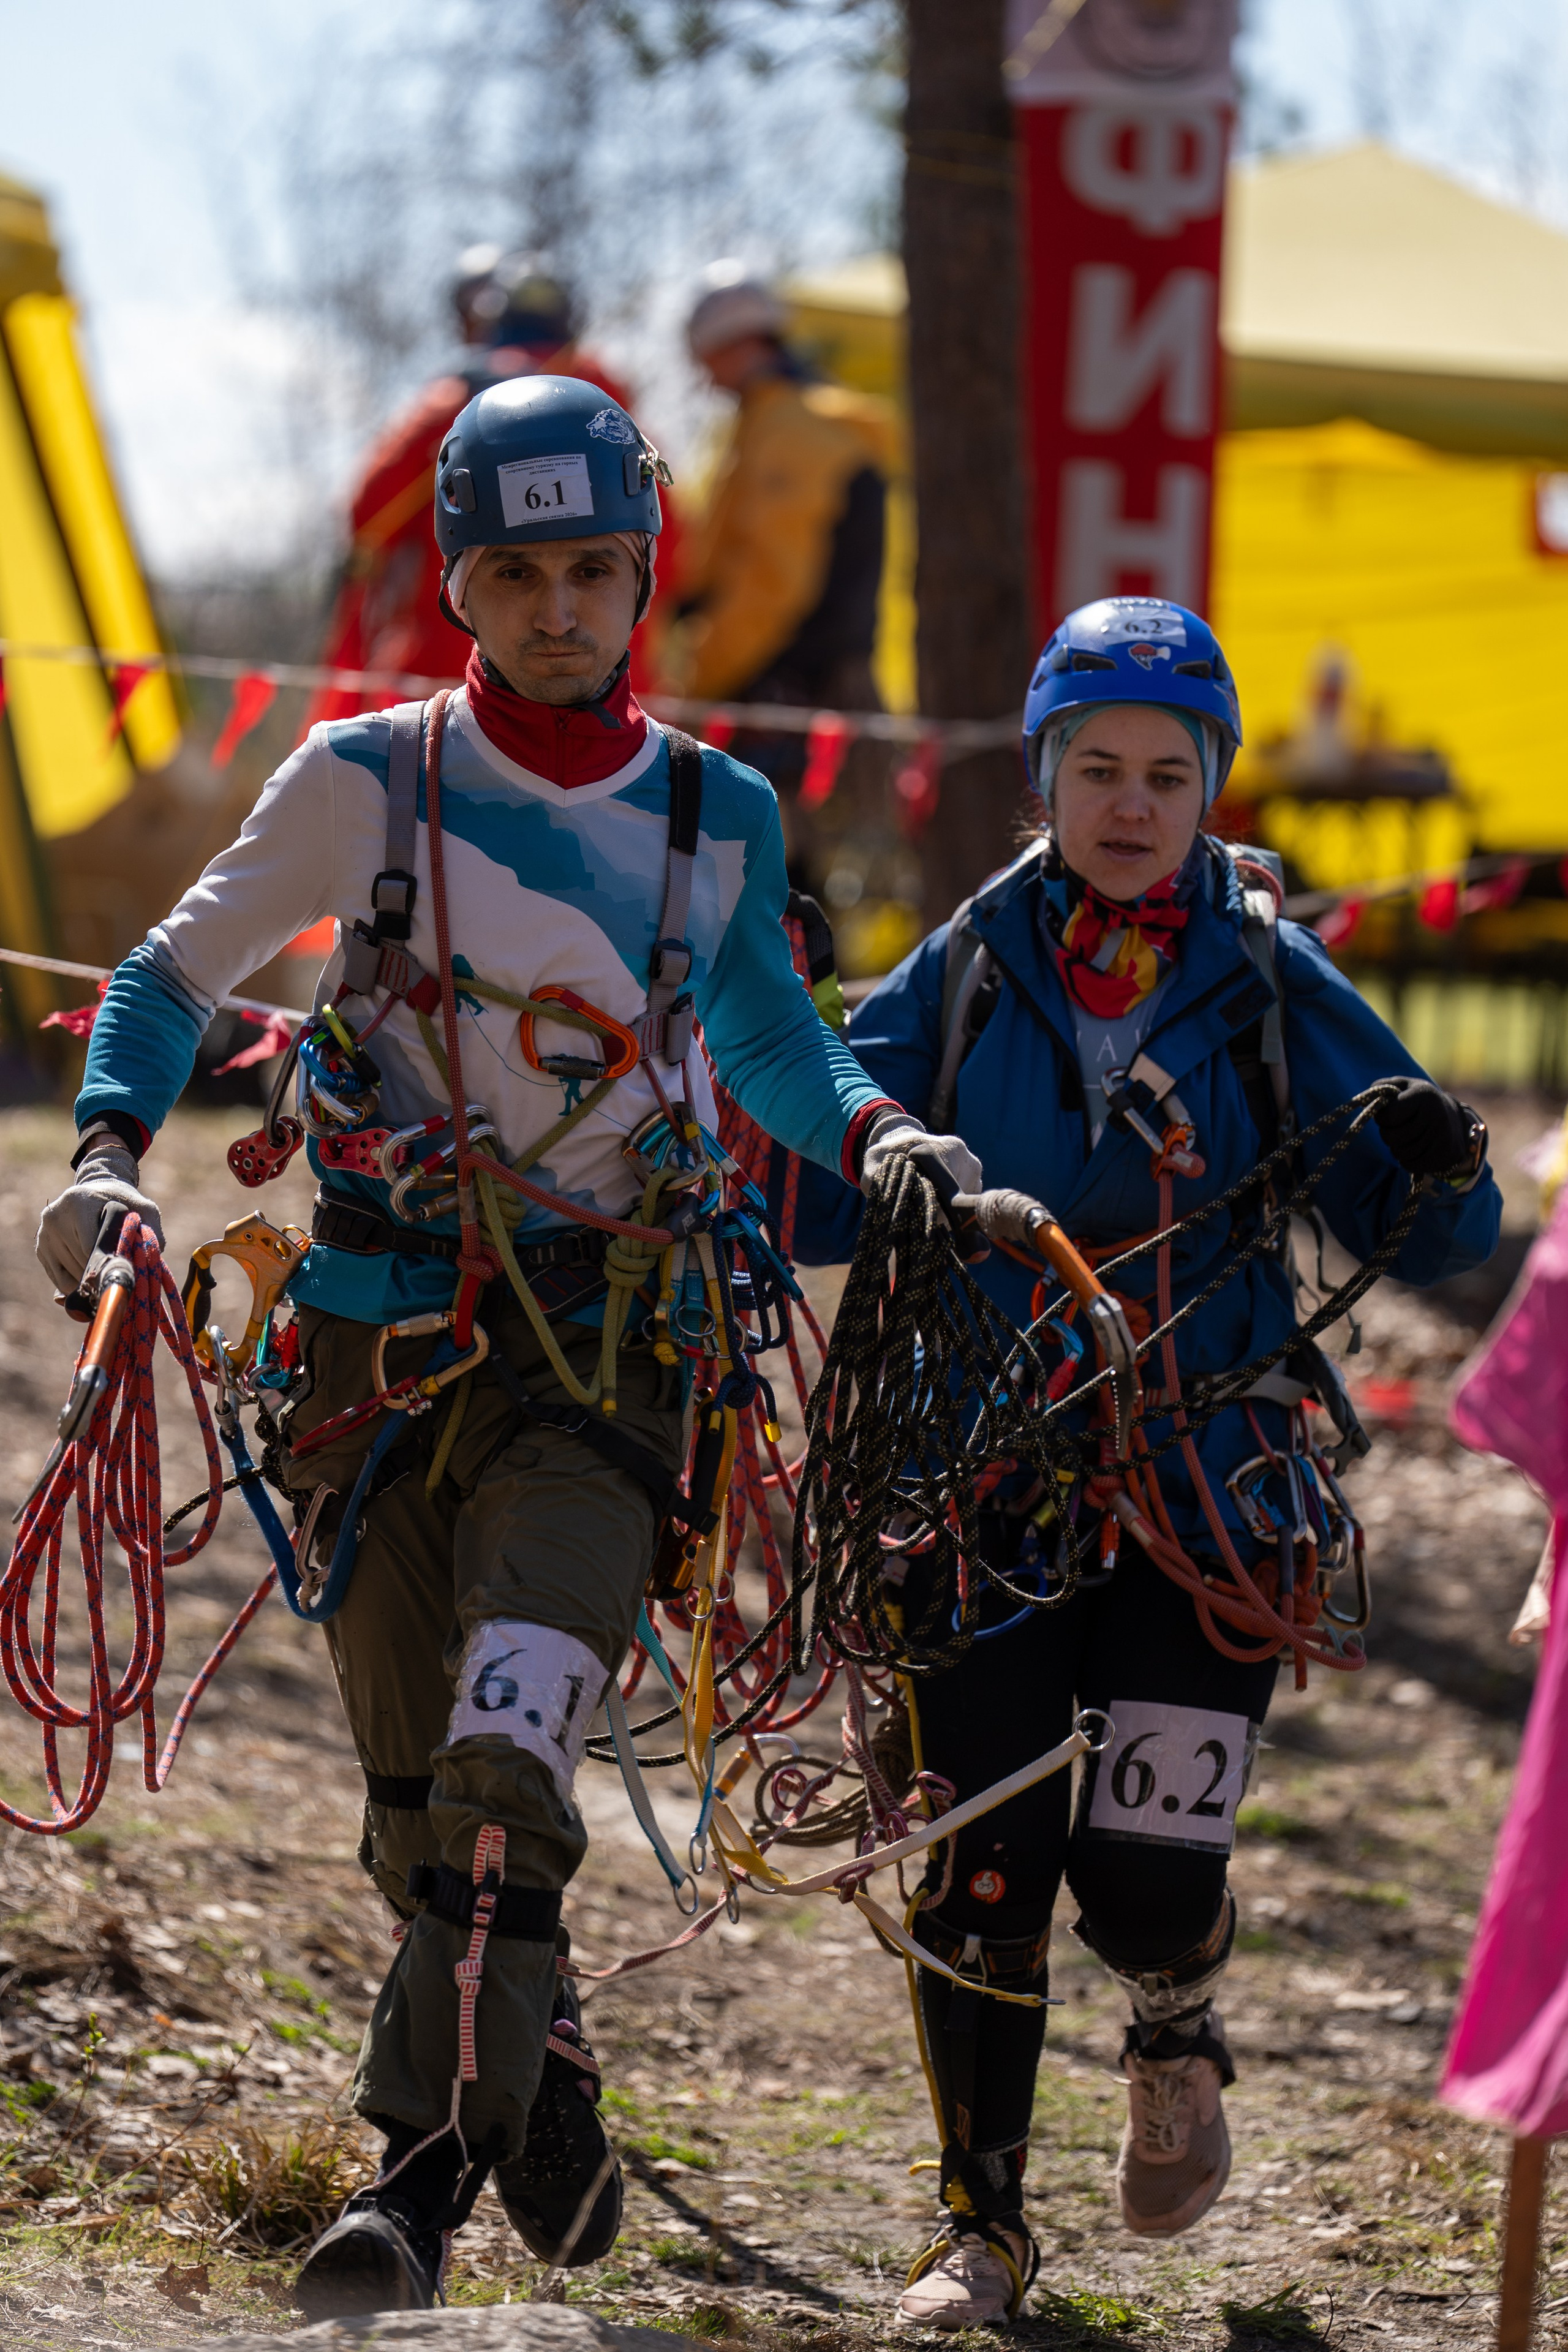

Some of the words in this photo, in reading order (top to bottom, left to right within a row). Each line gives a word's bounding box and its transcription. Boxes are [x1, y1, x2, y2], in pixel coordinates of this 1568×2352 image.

[501, 459, 543, 469] Межрегиональные
[505, 466, 534, 474] спортивному
[525, 480, 567, 510] 6.1
[1125, 619, 1162, 634] 6.2
[470, 1649, 584, 1757] 6.1
[1111, 1732, 1227, 1817] 6.2
